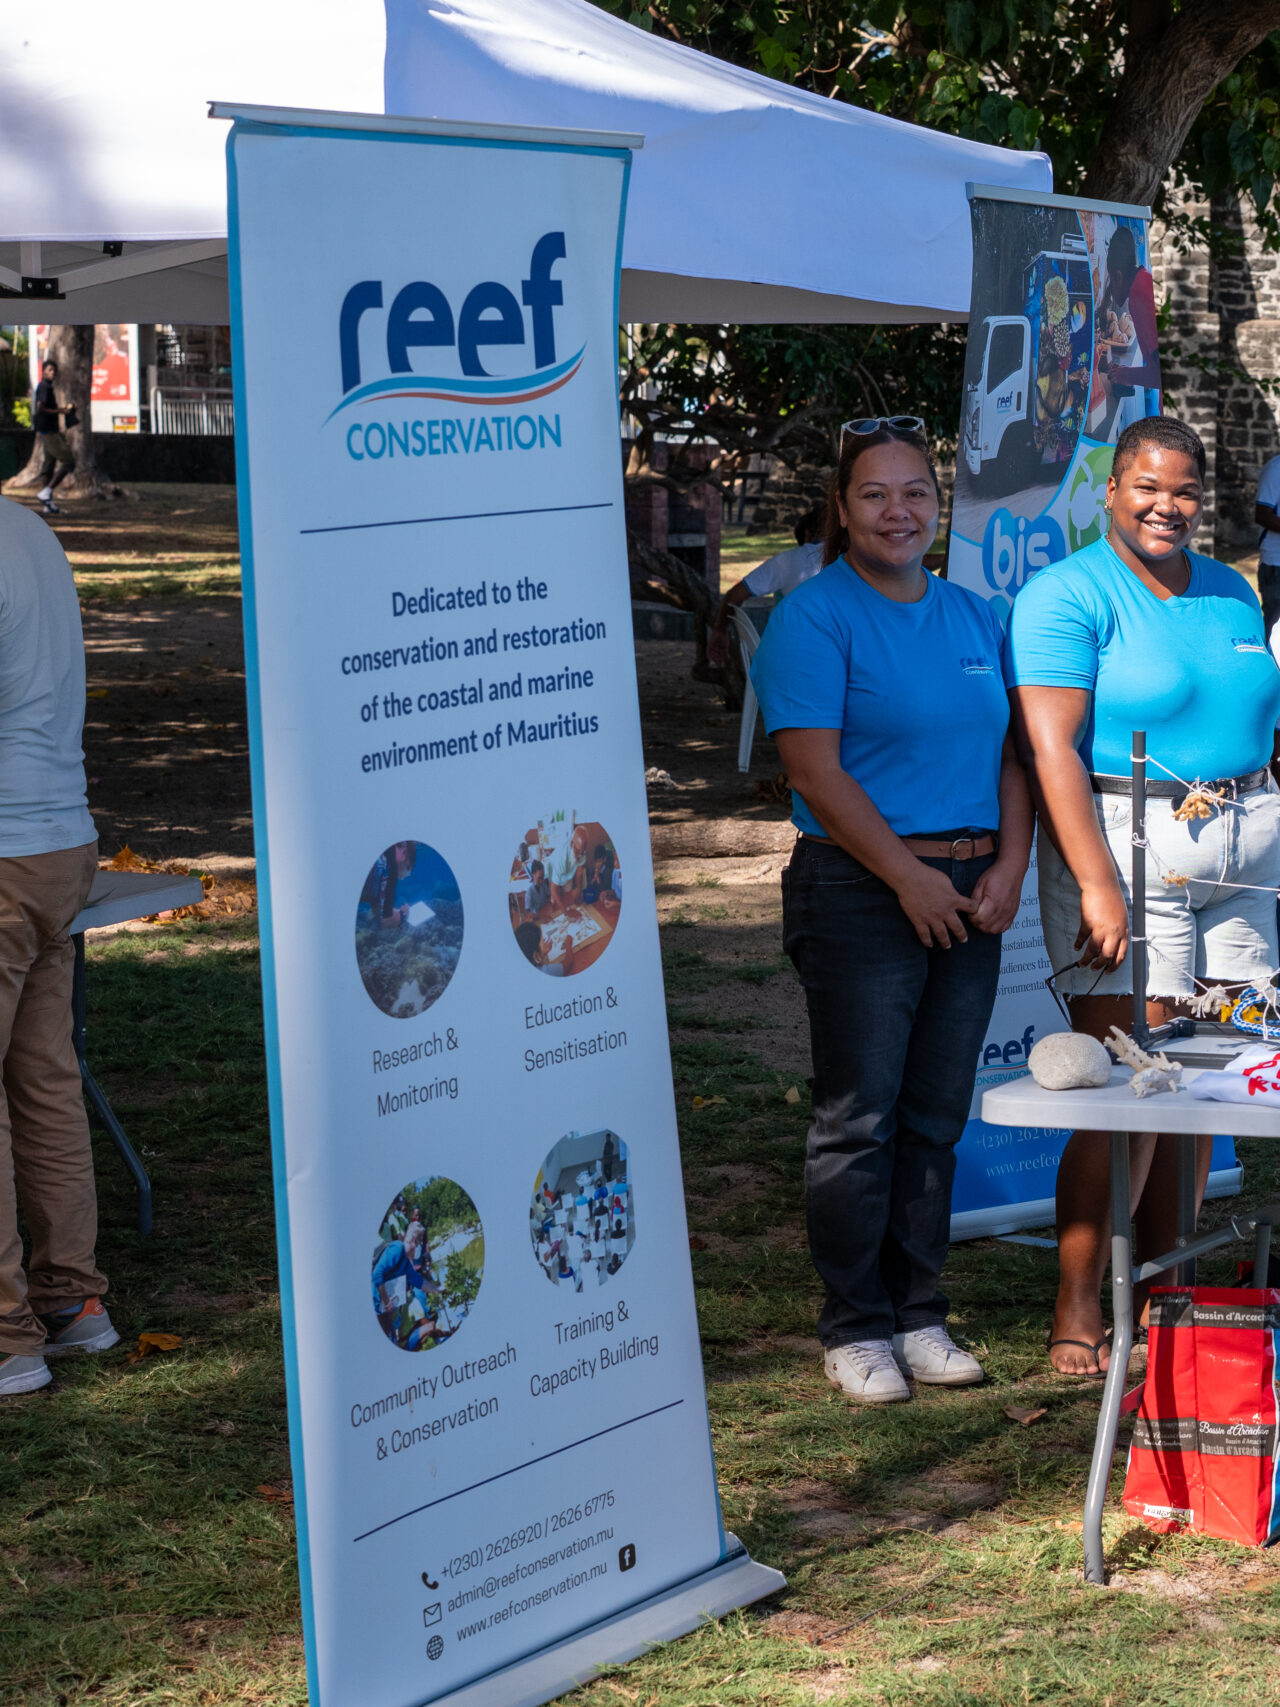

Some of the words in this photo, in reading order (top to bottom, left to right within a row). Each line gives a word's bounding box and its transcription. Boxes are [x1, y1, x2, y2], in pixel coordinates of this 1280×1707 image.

[339, 231, 567, 396] reef
[346, 414, 562, 461] CONSERVATION
[993, 517, 1051, 589] bis
[392, 581, 487, 618] Dedicated
[491, 582, 511, 604] to
[516, 576, 548, 602] the
[341, 636, 458, 676] conservation
[463, 628, 498, 658] and
[502, 617, 607, 652] restoration
[361, 694, 379, 723] of
[383, 691, 413, 720] the
[417, 678, 485, 713] coastal
[488, 672, 523, 701] and
[527, 666, 595, 696] marine
[361, 730, 479, 773] environment
[483, 723, 503, 751] of
[507, 711, 600, 747] Mauritius
[525, 991, 602, 1031] Education
[605, 986, 619, 1010] &
[372, 1031, 444, 1073] Research
[446, 1027, 460, 1051] &
[524, 1029, 628, 1072] Sensitisation
[981, 1025, 1035, 1067] eef
[377, 1075, 460, 1118] Monitoring
[974, 1070, 1031, 1087] ONSERVATIO
[554, 1305, 614, 1345] Training
[617, 1299, 630, 1322] &
[1193, 1310, 1224, 1321] Bassin
[1225, 1311, 1275, 1322] d'Arcachon
[351, 1373, 439, 1429] Community
[442, 1342, 518, 1389] Outreach
[530, 1356, 598, 1398] Capacity
[599, 1332, 660, 1371] Building
[376, 1437, 390, 1462] &
[390, 1395, 500, 1455] Conservation
[1199, 1421, 1226, 1435] Bassin
[1226, 1423, 1269, 1436] d'Arcachon
[440, 1546, 484, 1582] +(230)
[485, 1521, 543, 1562] 2626920
[543, 1517, 550, 1538] /
[551, 1505, 583, 1533] 2626
[584, 1489, 617, 1519] 6775
[447, 1525, 615, 1614] admin@reefconservation.mu
[456, 1560, 608, 1643] www.reefconservation.mu
